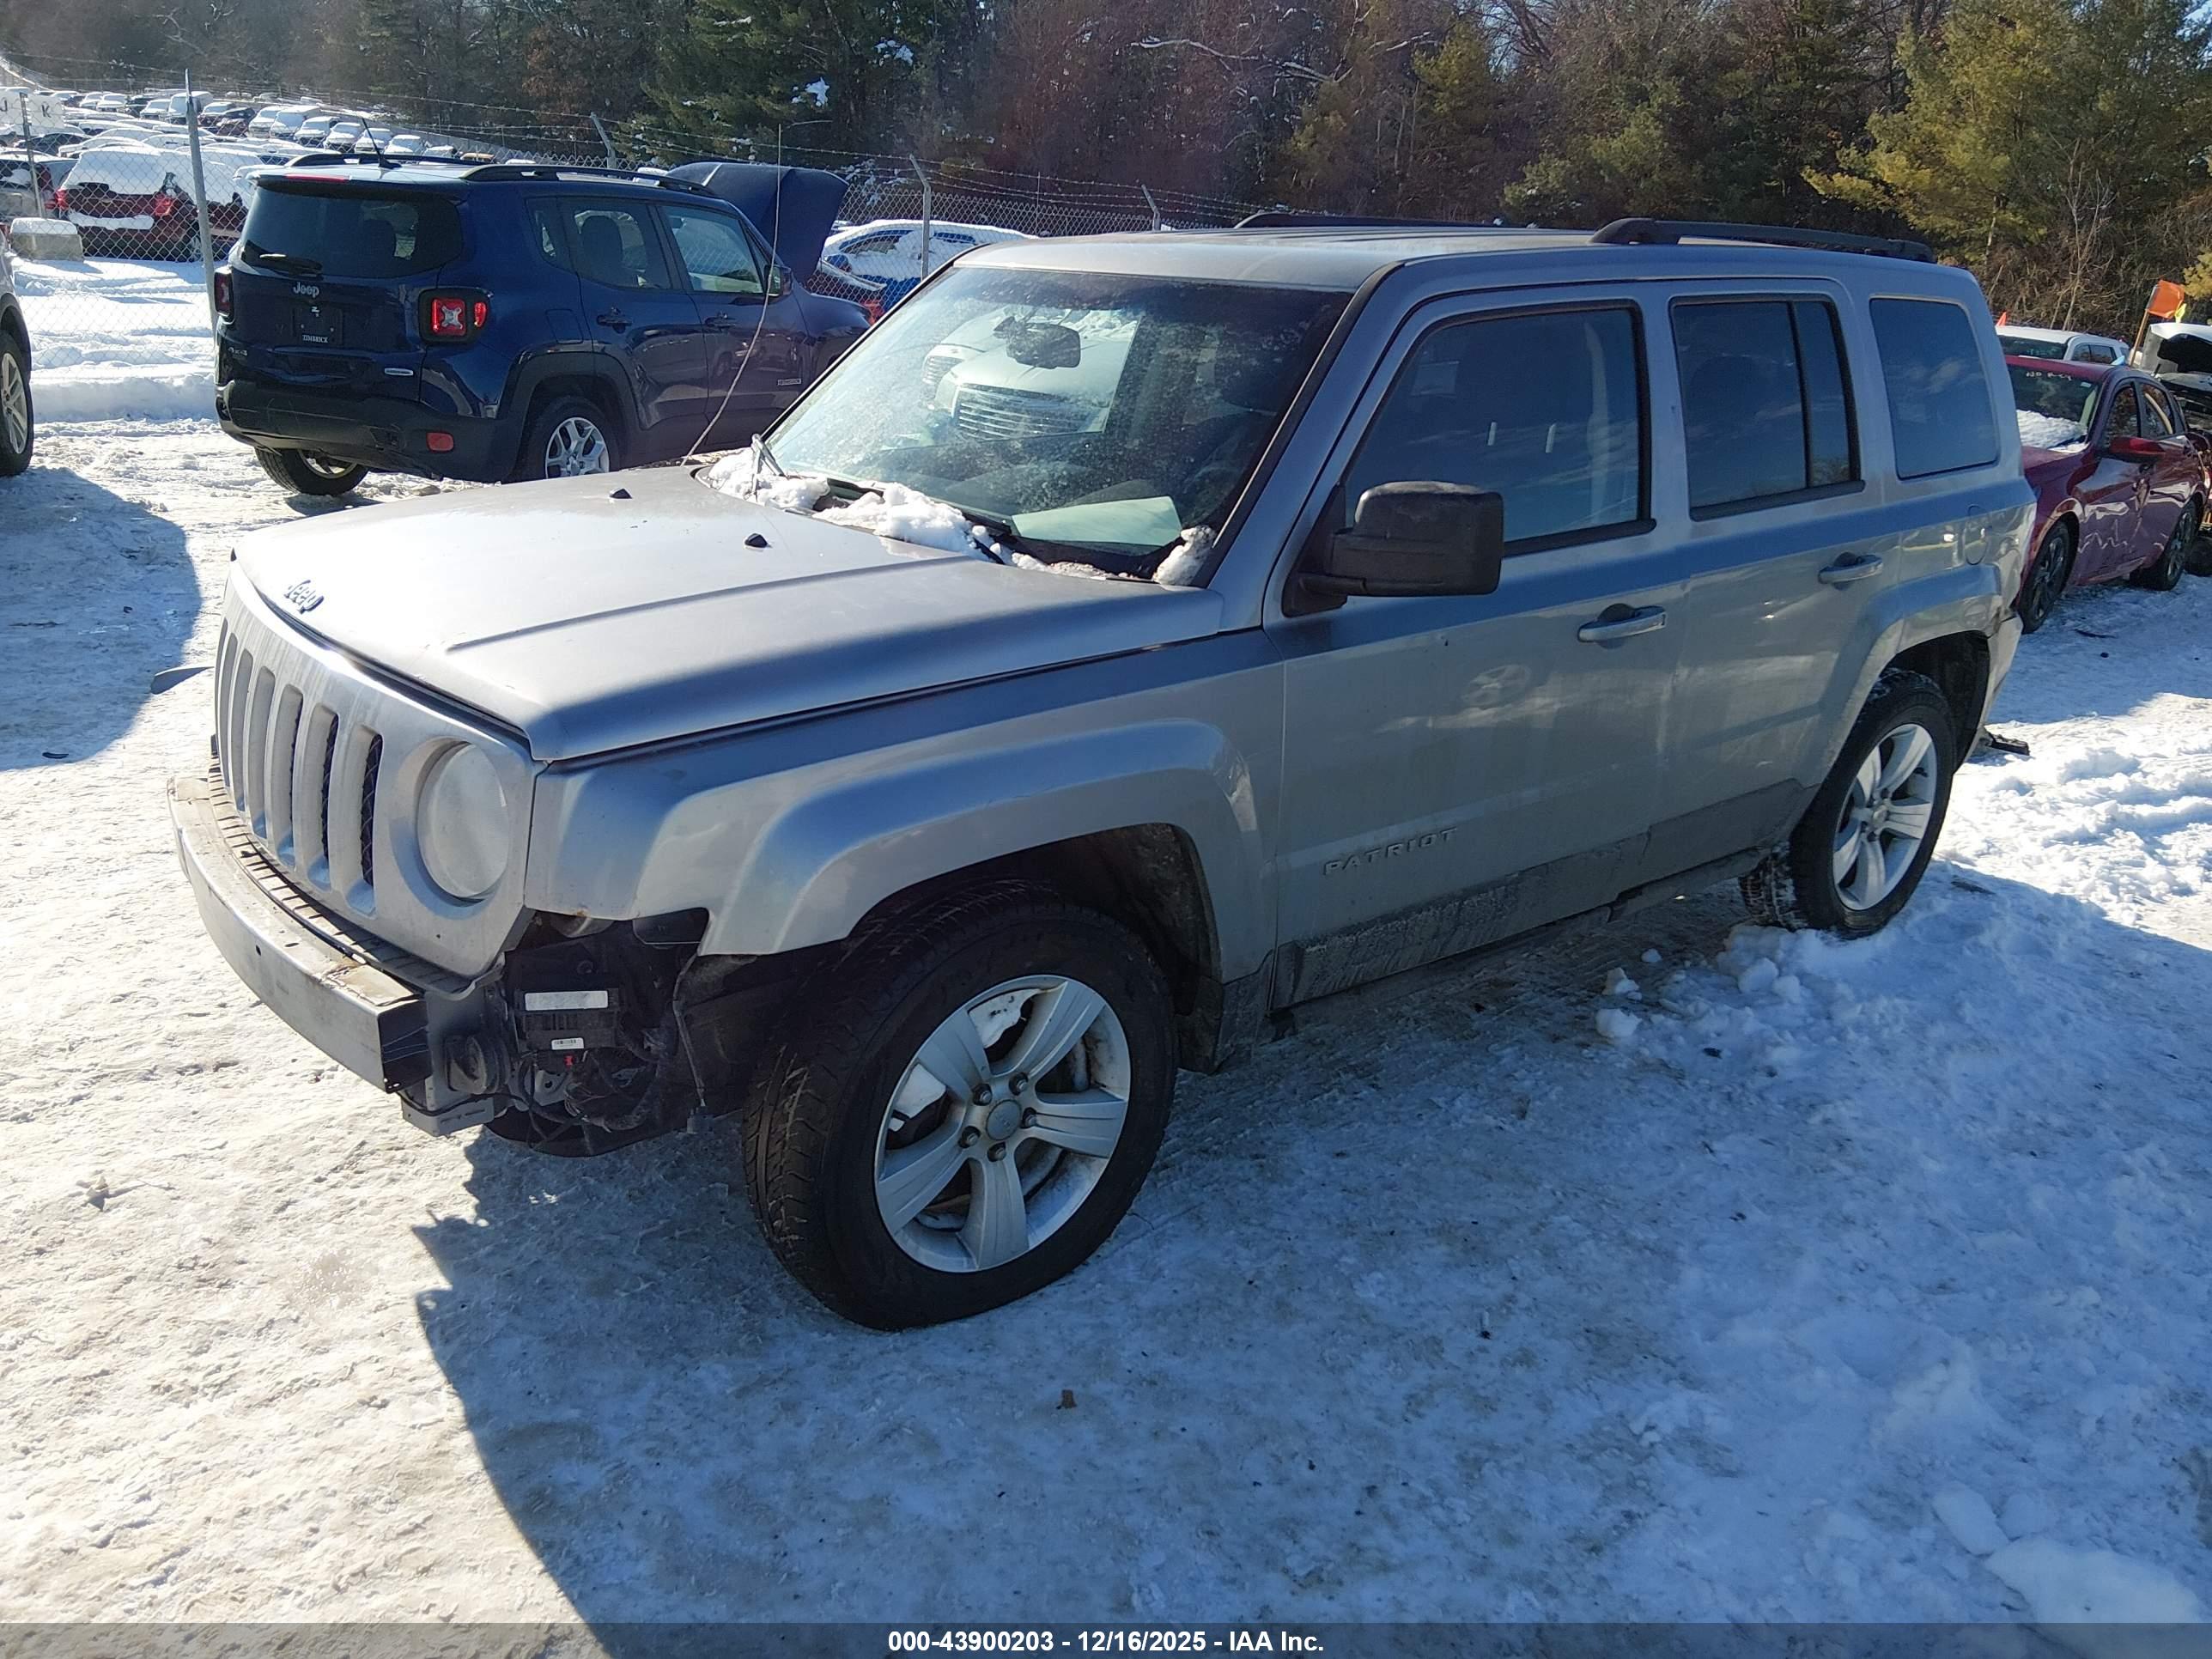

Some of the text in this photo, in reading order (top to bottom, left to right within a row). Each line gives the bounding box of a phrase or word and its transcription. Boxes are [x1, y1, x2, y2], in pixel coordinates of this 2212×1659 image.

[41, 104, 52, 118] K
[293, 282, 320, 299] Jeep
[283, 579, 325, 615] Jeep
[1322, 826, 1457, 876] PATRIOT
